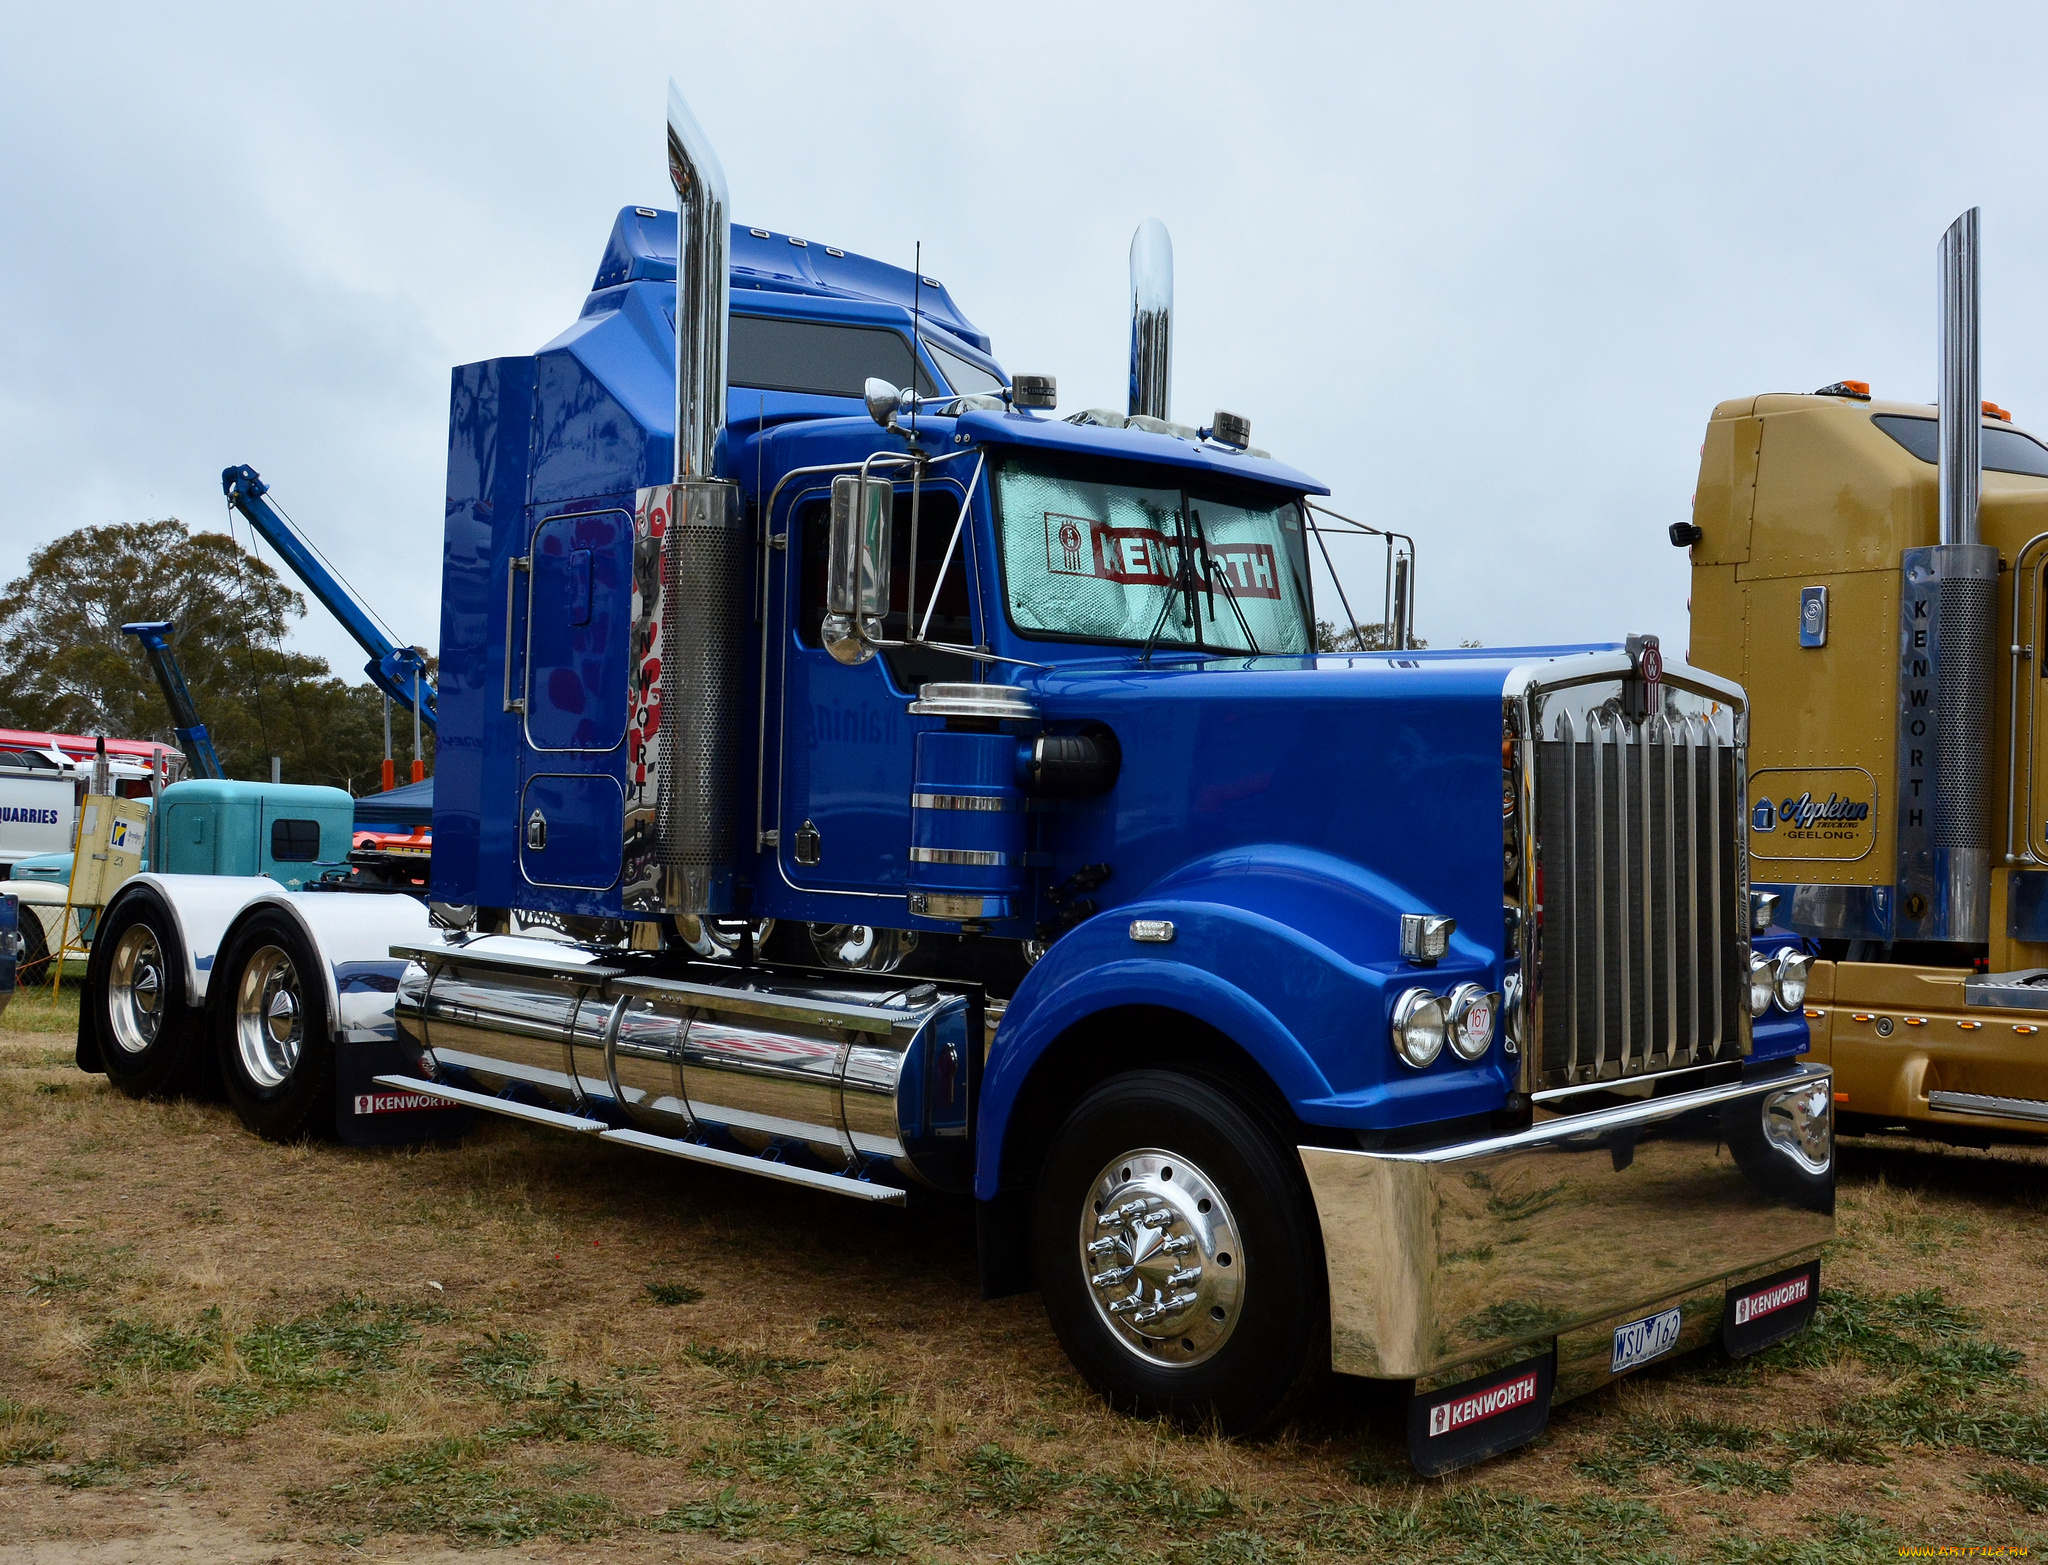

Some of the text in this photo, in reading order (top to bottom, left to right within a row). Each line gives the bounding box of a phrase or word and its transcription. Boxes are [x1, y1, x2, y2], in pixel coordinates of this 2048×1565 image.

[635, 556, 654, 840] KENWORTH
[1910, 600, 1929, 827] KENWORTH
[0, 806, 58, 825] UARRIES
[1779, 791, 1869, 829] Appleton
[1788, 831, 1854, 839] GEELONG
[1470, 1008, 1487, 1028] 167
[375, 1096, 457, 1111] KENWOR
[1750, 1280, 1808, 1316] KENWORTH
[1615, 1314, 1678, 1361] WSU 162
[1452, 1378, 1535, 1425] KENWORTH
